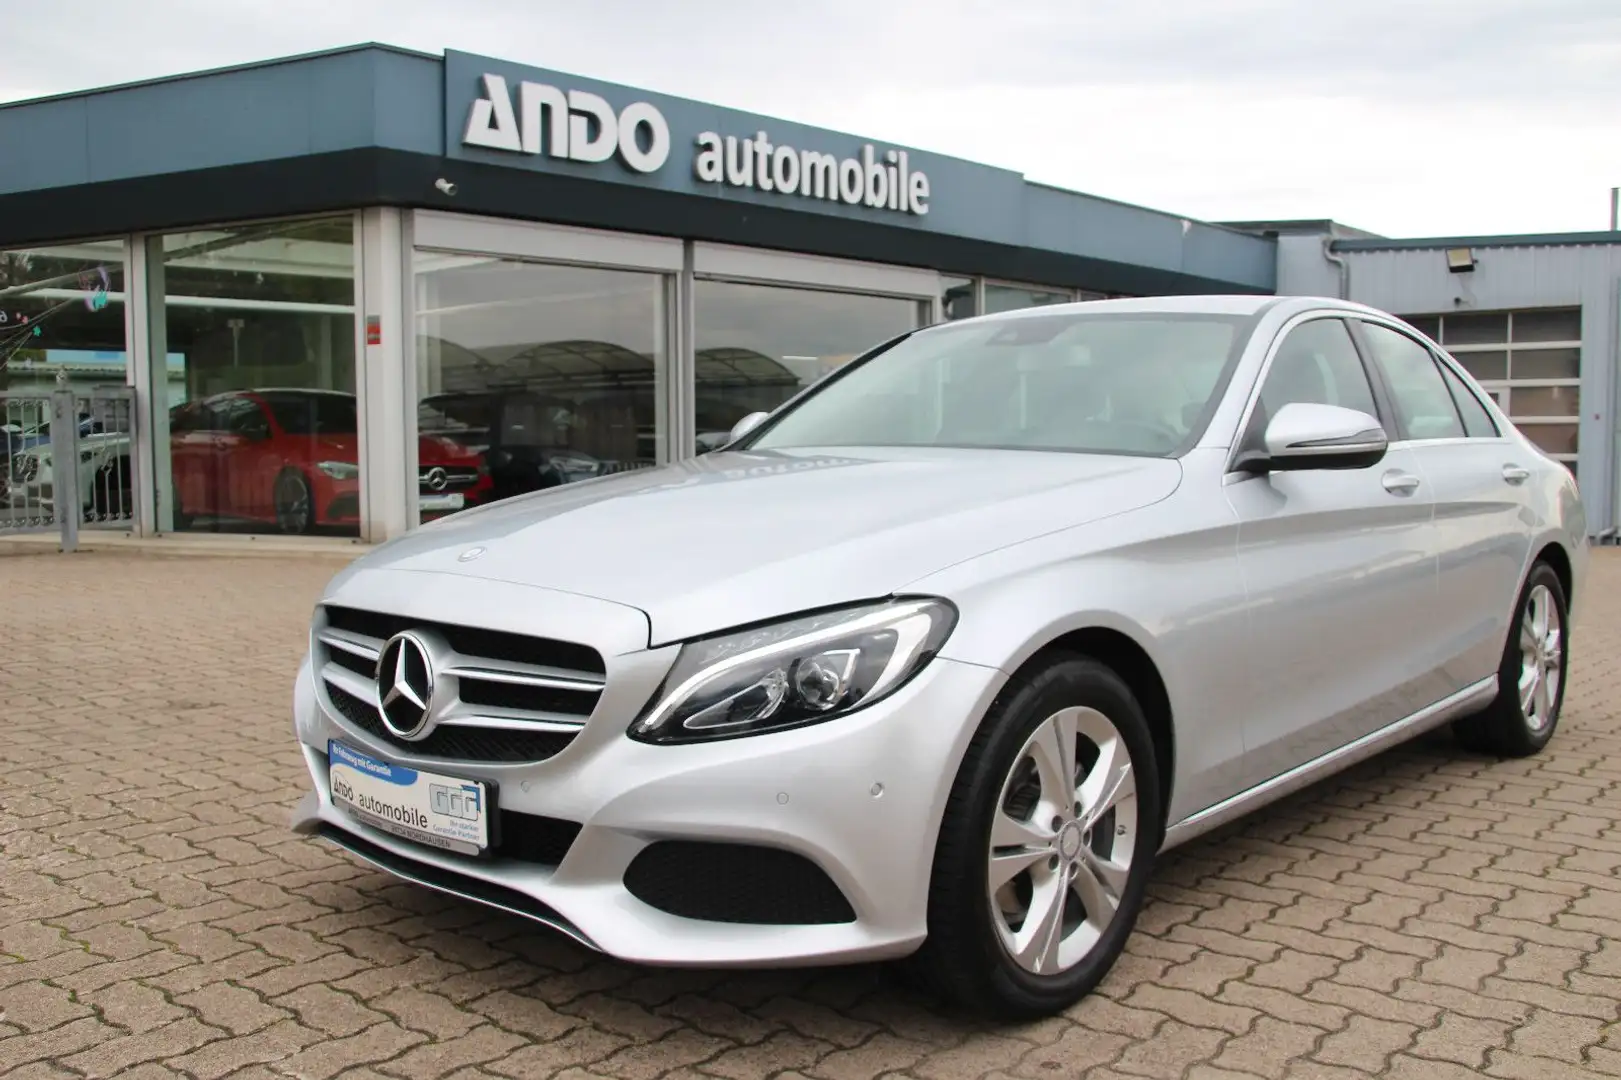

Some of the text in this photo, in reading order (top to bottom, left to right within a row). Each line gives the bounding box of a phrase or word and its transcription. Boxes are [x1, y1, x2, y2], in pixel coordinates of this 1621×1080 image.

[464, 73, 929, 214] ANDO automobile
[359, 794, 428, 829] automobile
